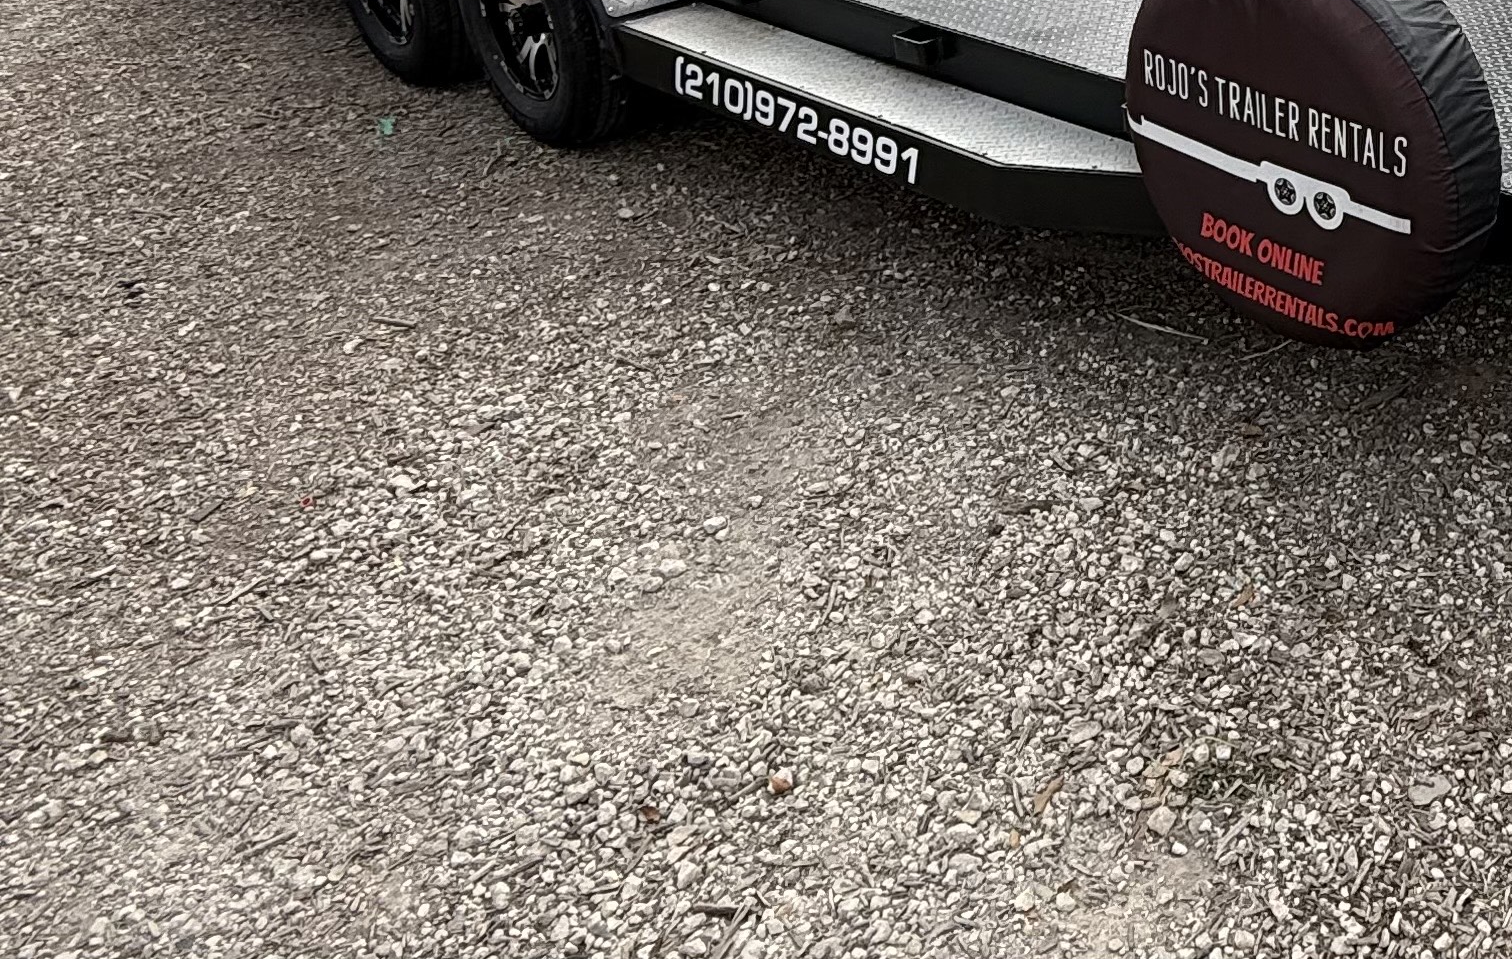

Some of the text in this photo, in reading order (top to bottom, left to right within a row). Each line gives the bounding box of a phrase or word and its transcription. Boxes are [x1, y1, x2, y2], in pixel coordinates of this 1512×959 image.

[675, 55, 919, 185] (210)972-8991
[1143, 48, 1408, 178] ROJO'S TRAILER RENTALS
[1200, 212, 1325, 286] BOOK ONLINE
